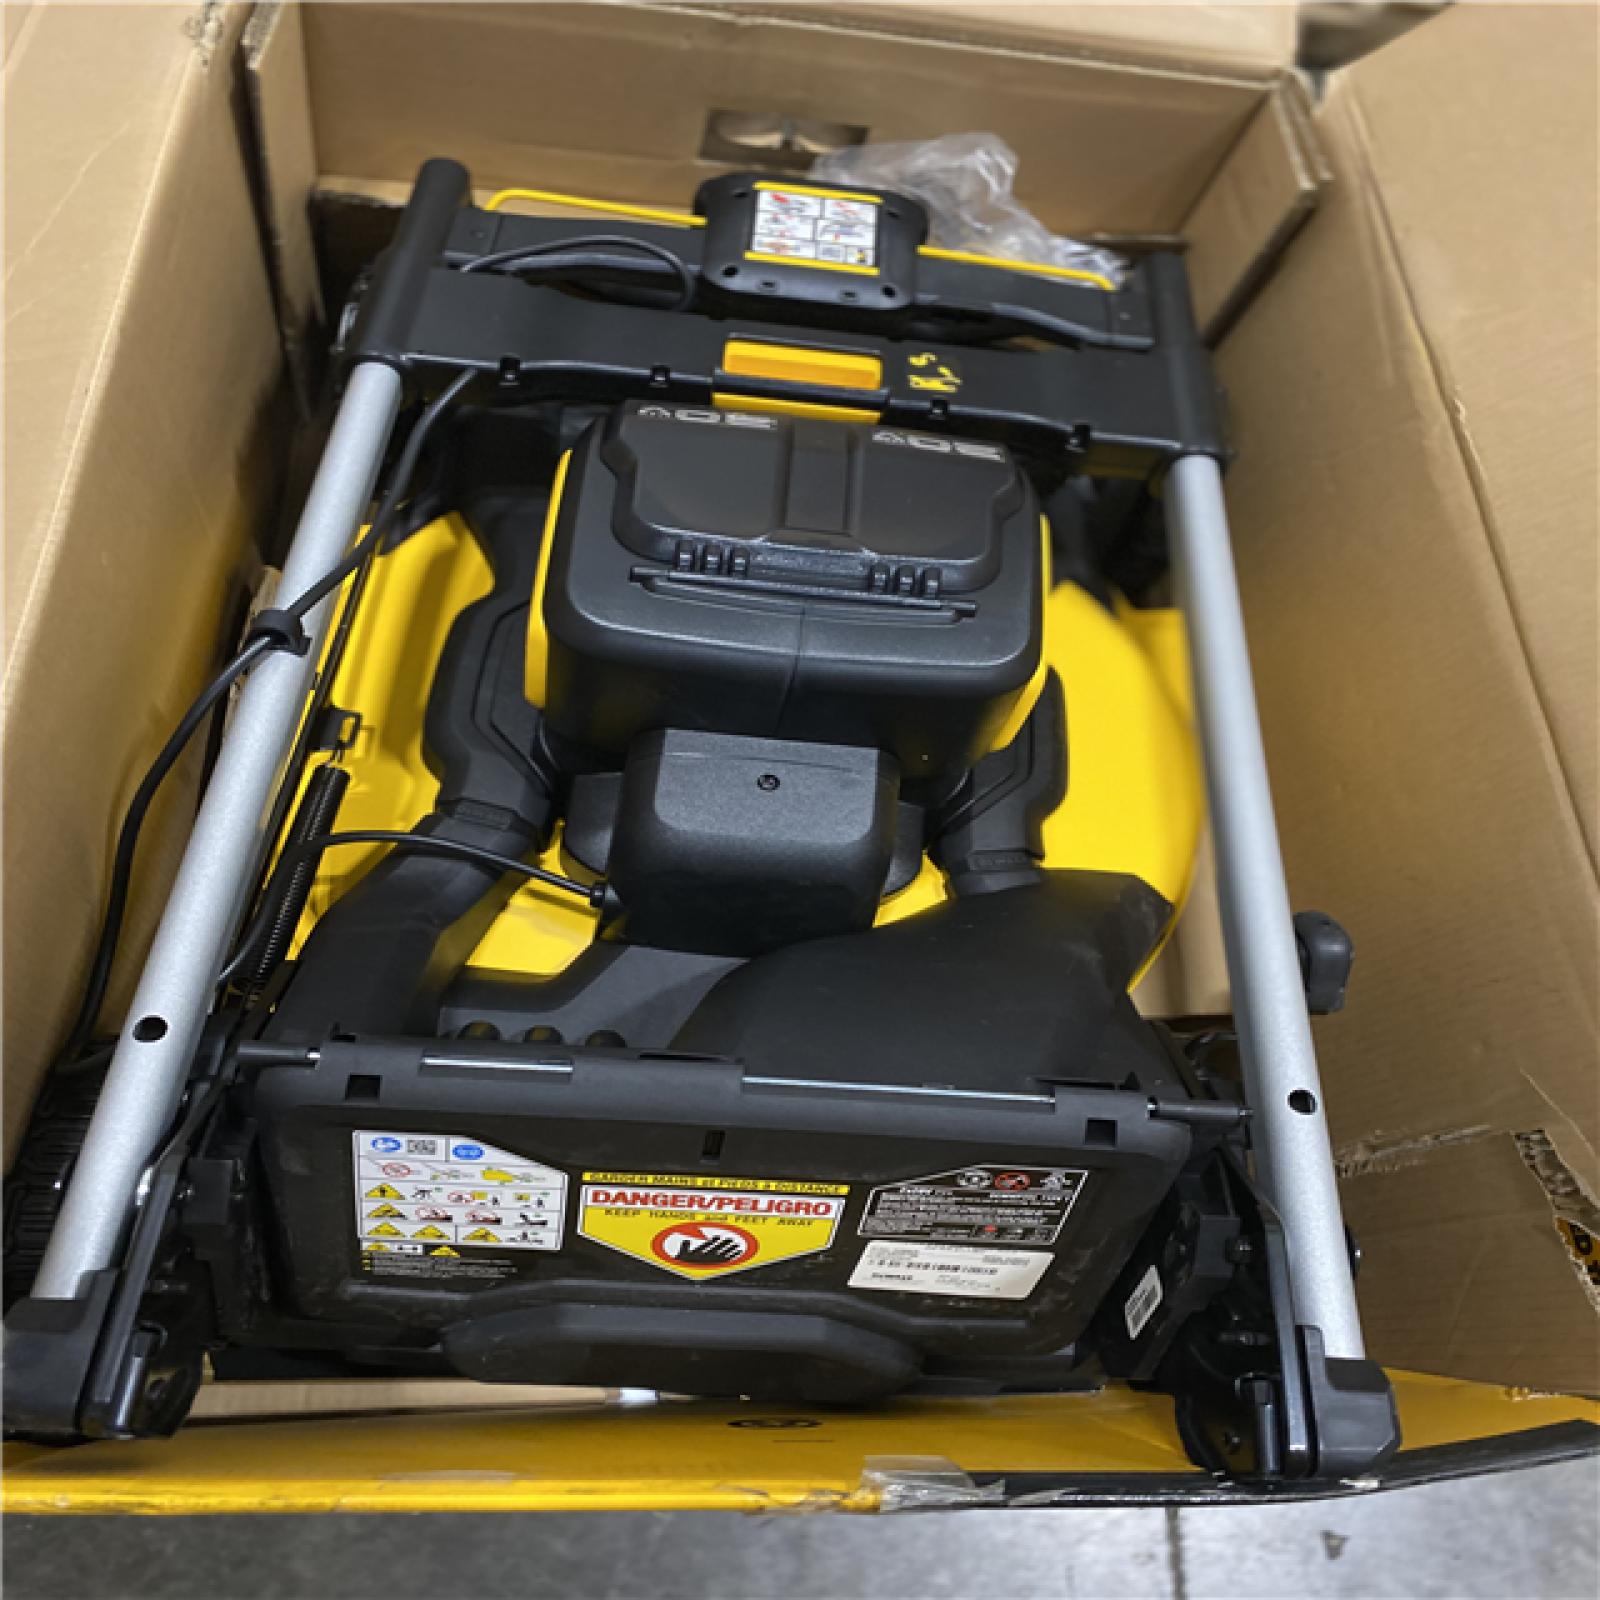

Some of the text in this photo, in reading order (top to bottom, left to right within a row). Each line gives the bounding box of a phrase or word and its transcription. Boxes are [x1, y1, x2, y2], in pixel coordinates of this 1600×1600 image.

[591, 1189, 832, 1216] DANGER/PELIGRO
[604, 1208, 641, 1217] KEEP
[649, 1210, 695, 1221] HANDS
[735, 1214, 768, 1224] FEET
[776, 1217, 814, 1226] AWAY
